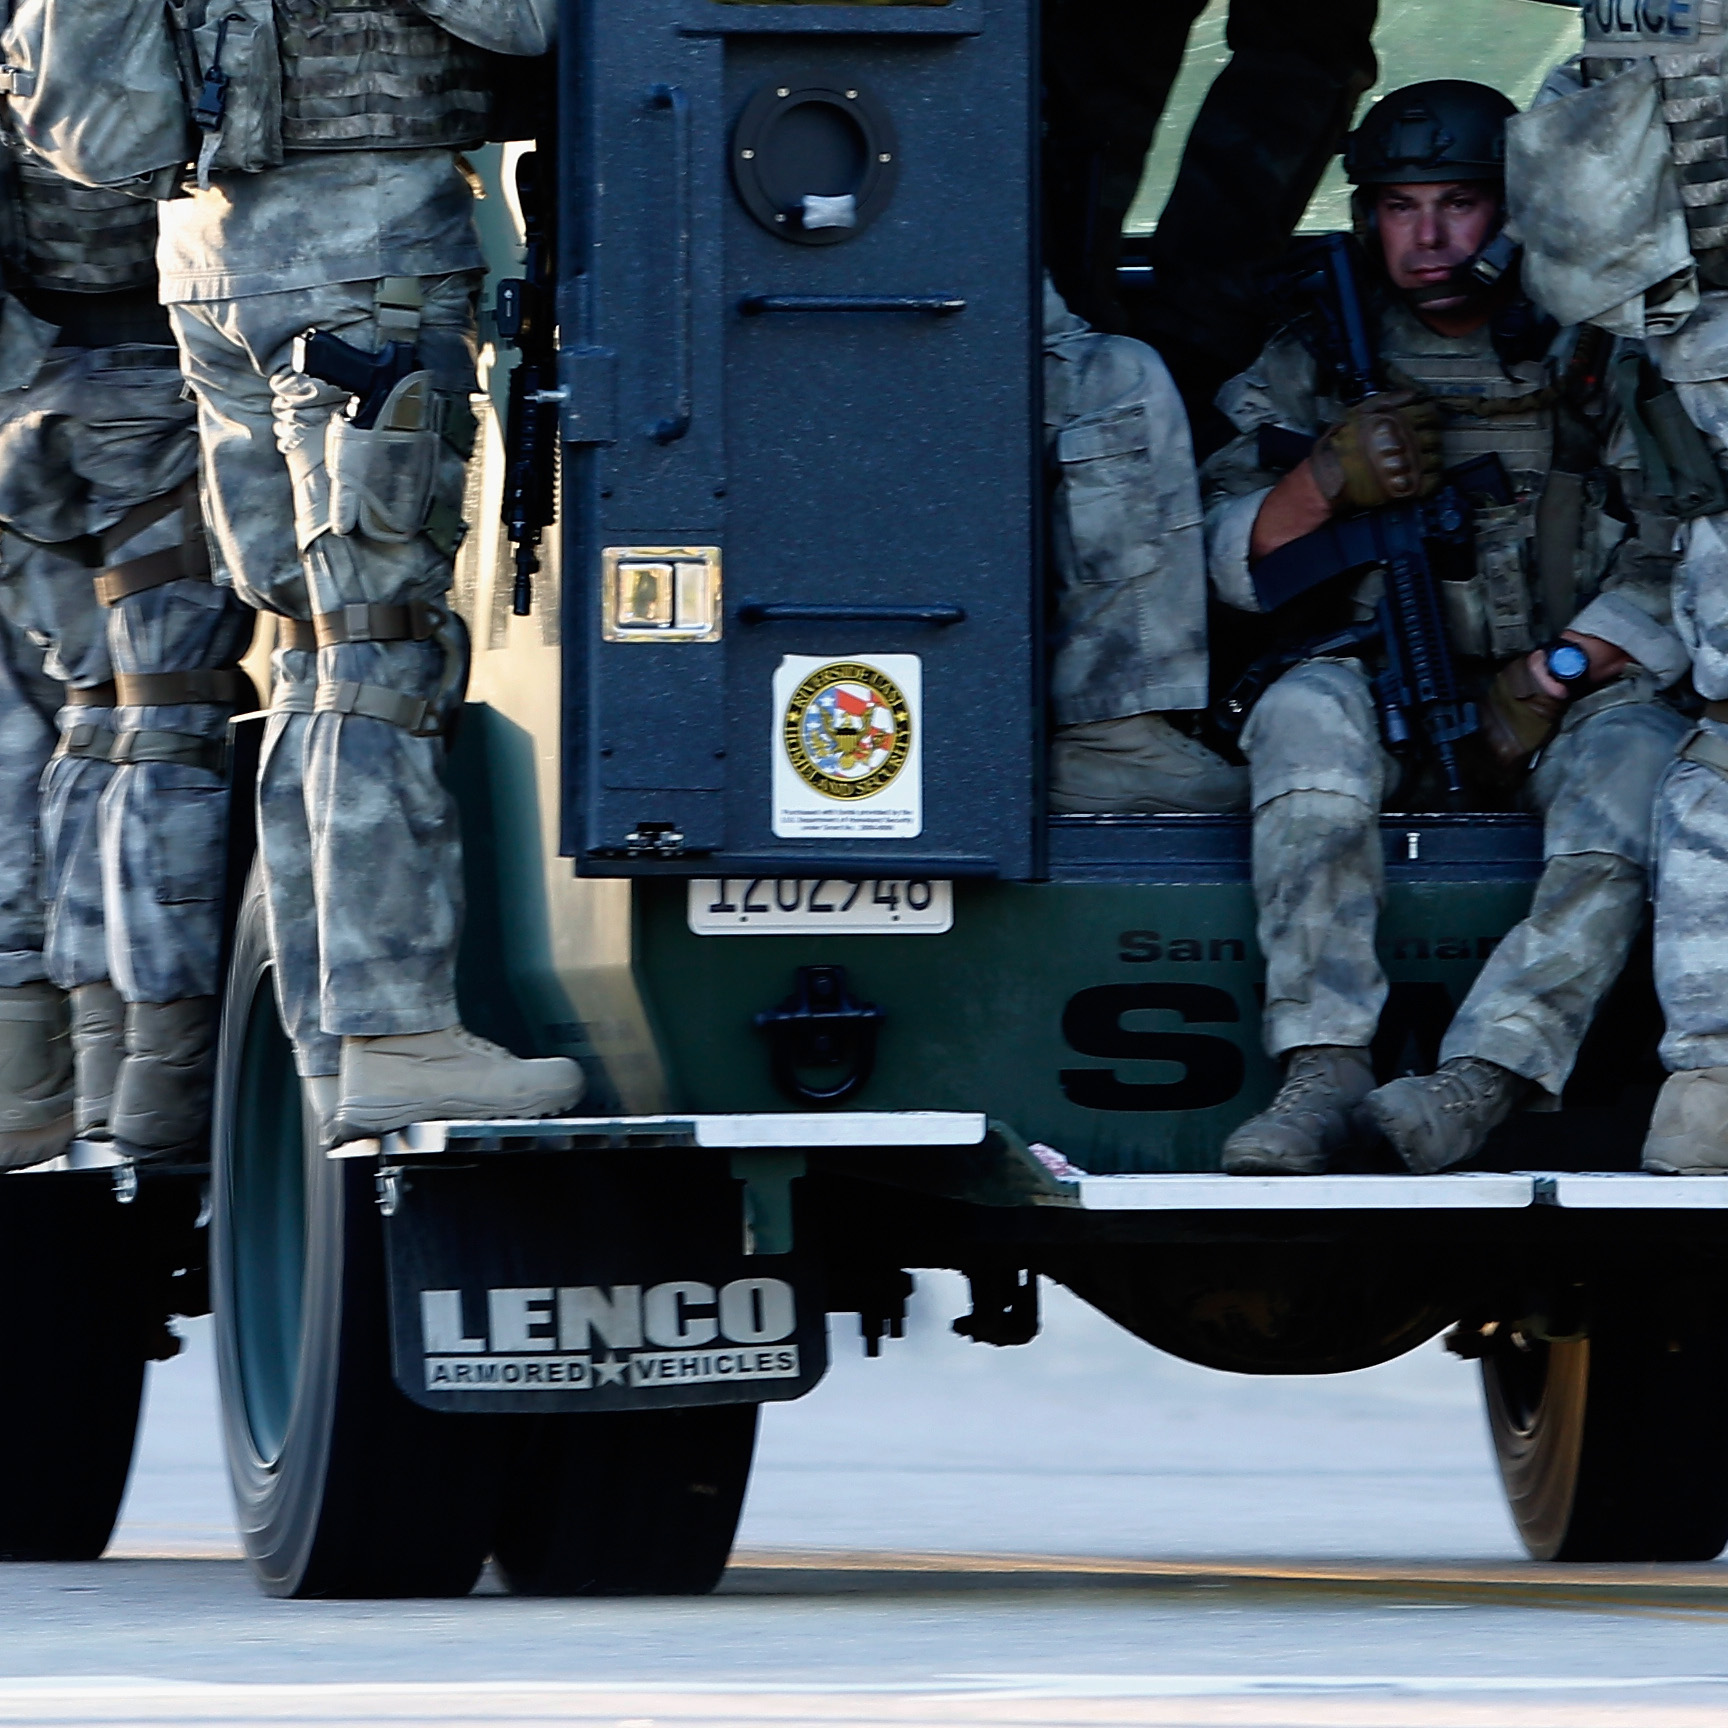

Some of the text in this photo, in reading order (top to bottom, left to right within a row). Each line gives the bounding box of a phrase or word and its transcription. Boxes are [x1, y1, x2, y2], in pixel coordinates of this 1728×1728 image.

[1118, 929, 1246, 963] San
[420, 1277, 796, 1354] LENCO
[431, 1351, 797, 1385] ARMORED VEHICLES
